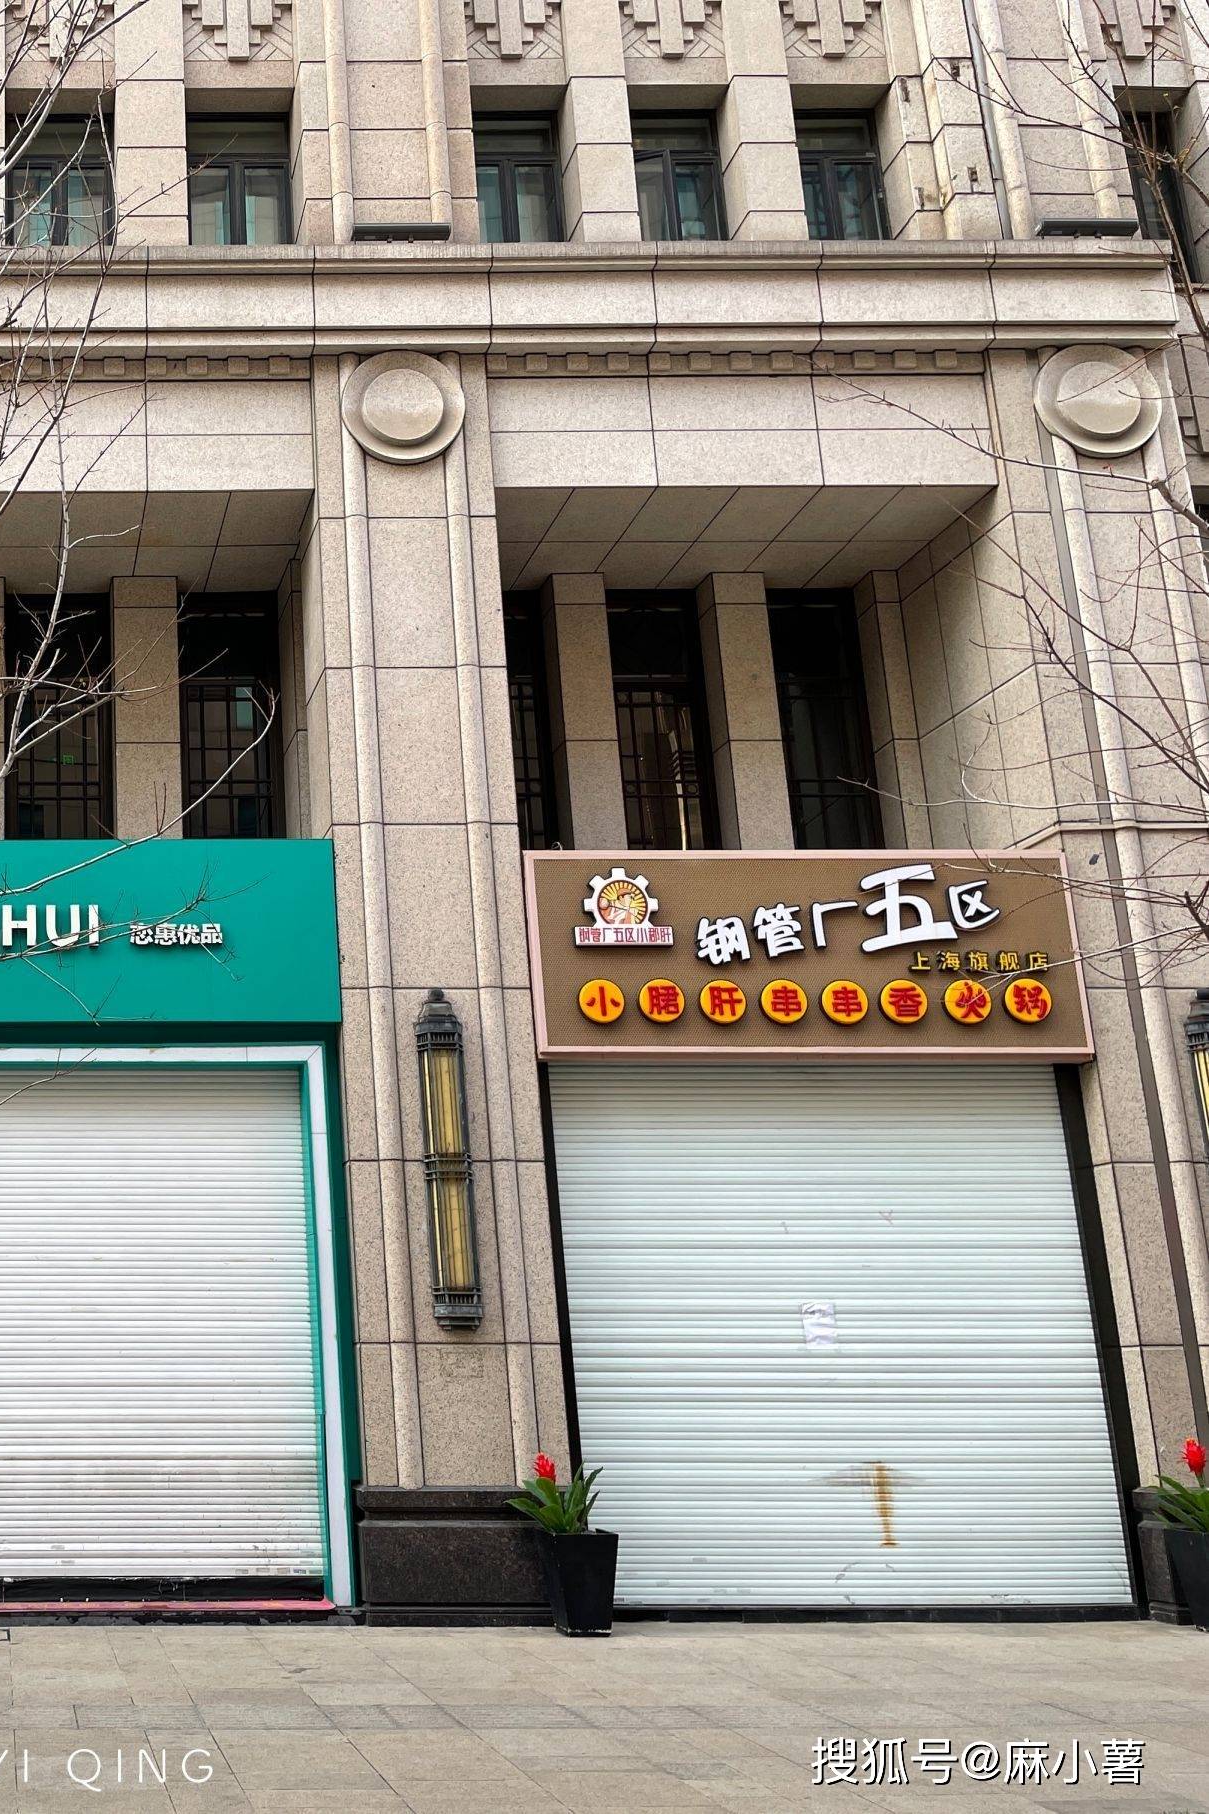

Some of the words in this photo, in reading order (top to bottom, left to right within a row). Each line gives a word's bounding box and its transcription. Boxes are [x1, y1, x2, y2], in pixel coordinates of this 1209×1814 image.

[697, 863, 1000, 965] 钢管厂五区
[911, 951, 1050, 972] 上海旗舰店
